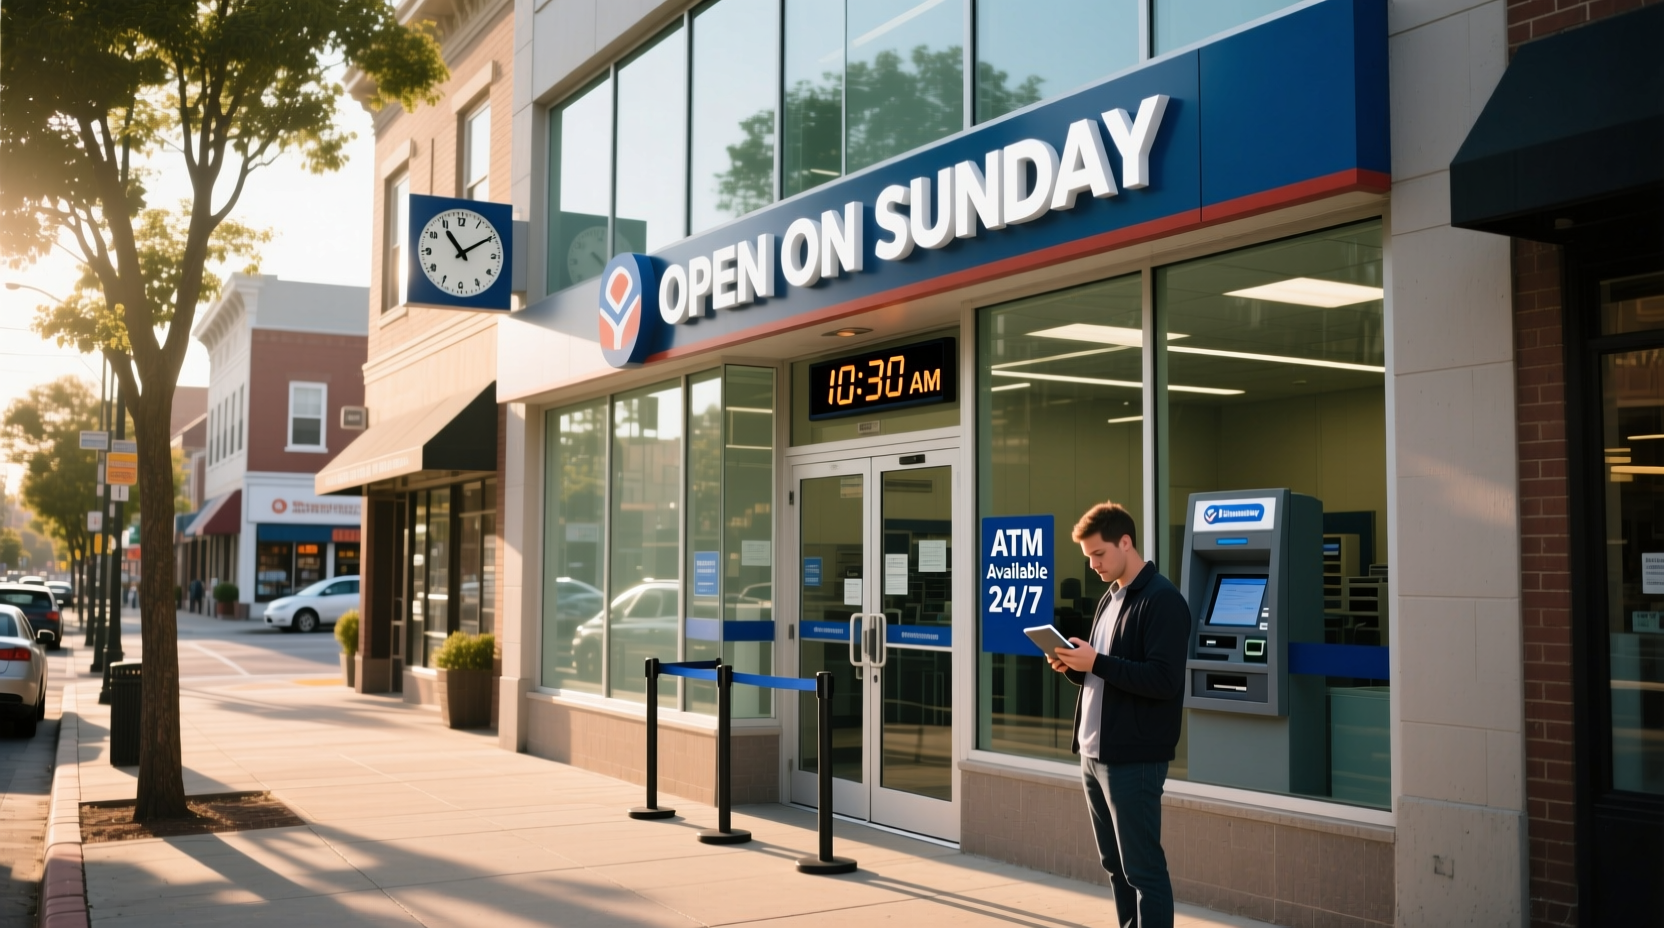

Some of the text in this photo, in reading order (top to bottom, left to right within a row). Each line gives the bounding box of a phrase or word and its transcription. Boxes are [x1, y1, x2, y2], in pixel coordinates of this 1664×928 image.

[658, 94, 1170, 325] OPEN ON SUNDAY
[828, 355, 941, 406] 10:30 AM
[990, 528, 1043, 557] ATM
[986, 562, 1048, 579] Available
[988, 585, 1043, 617] 24/7
